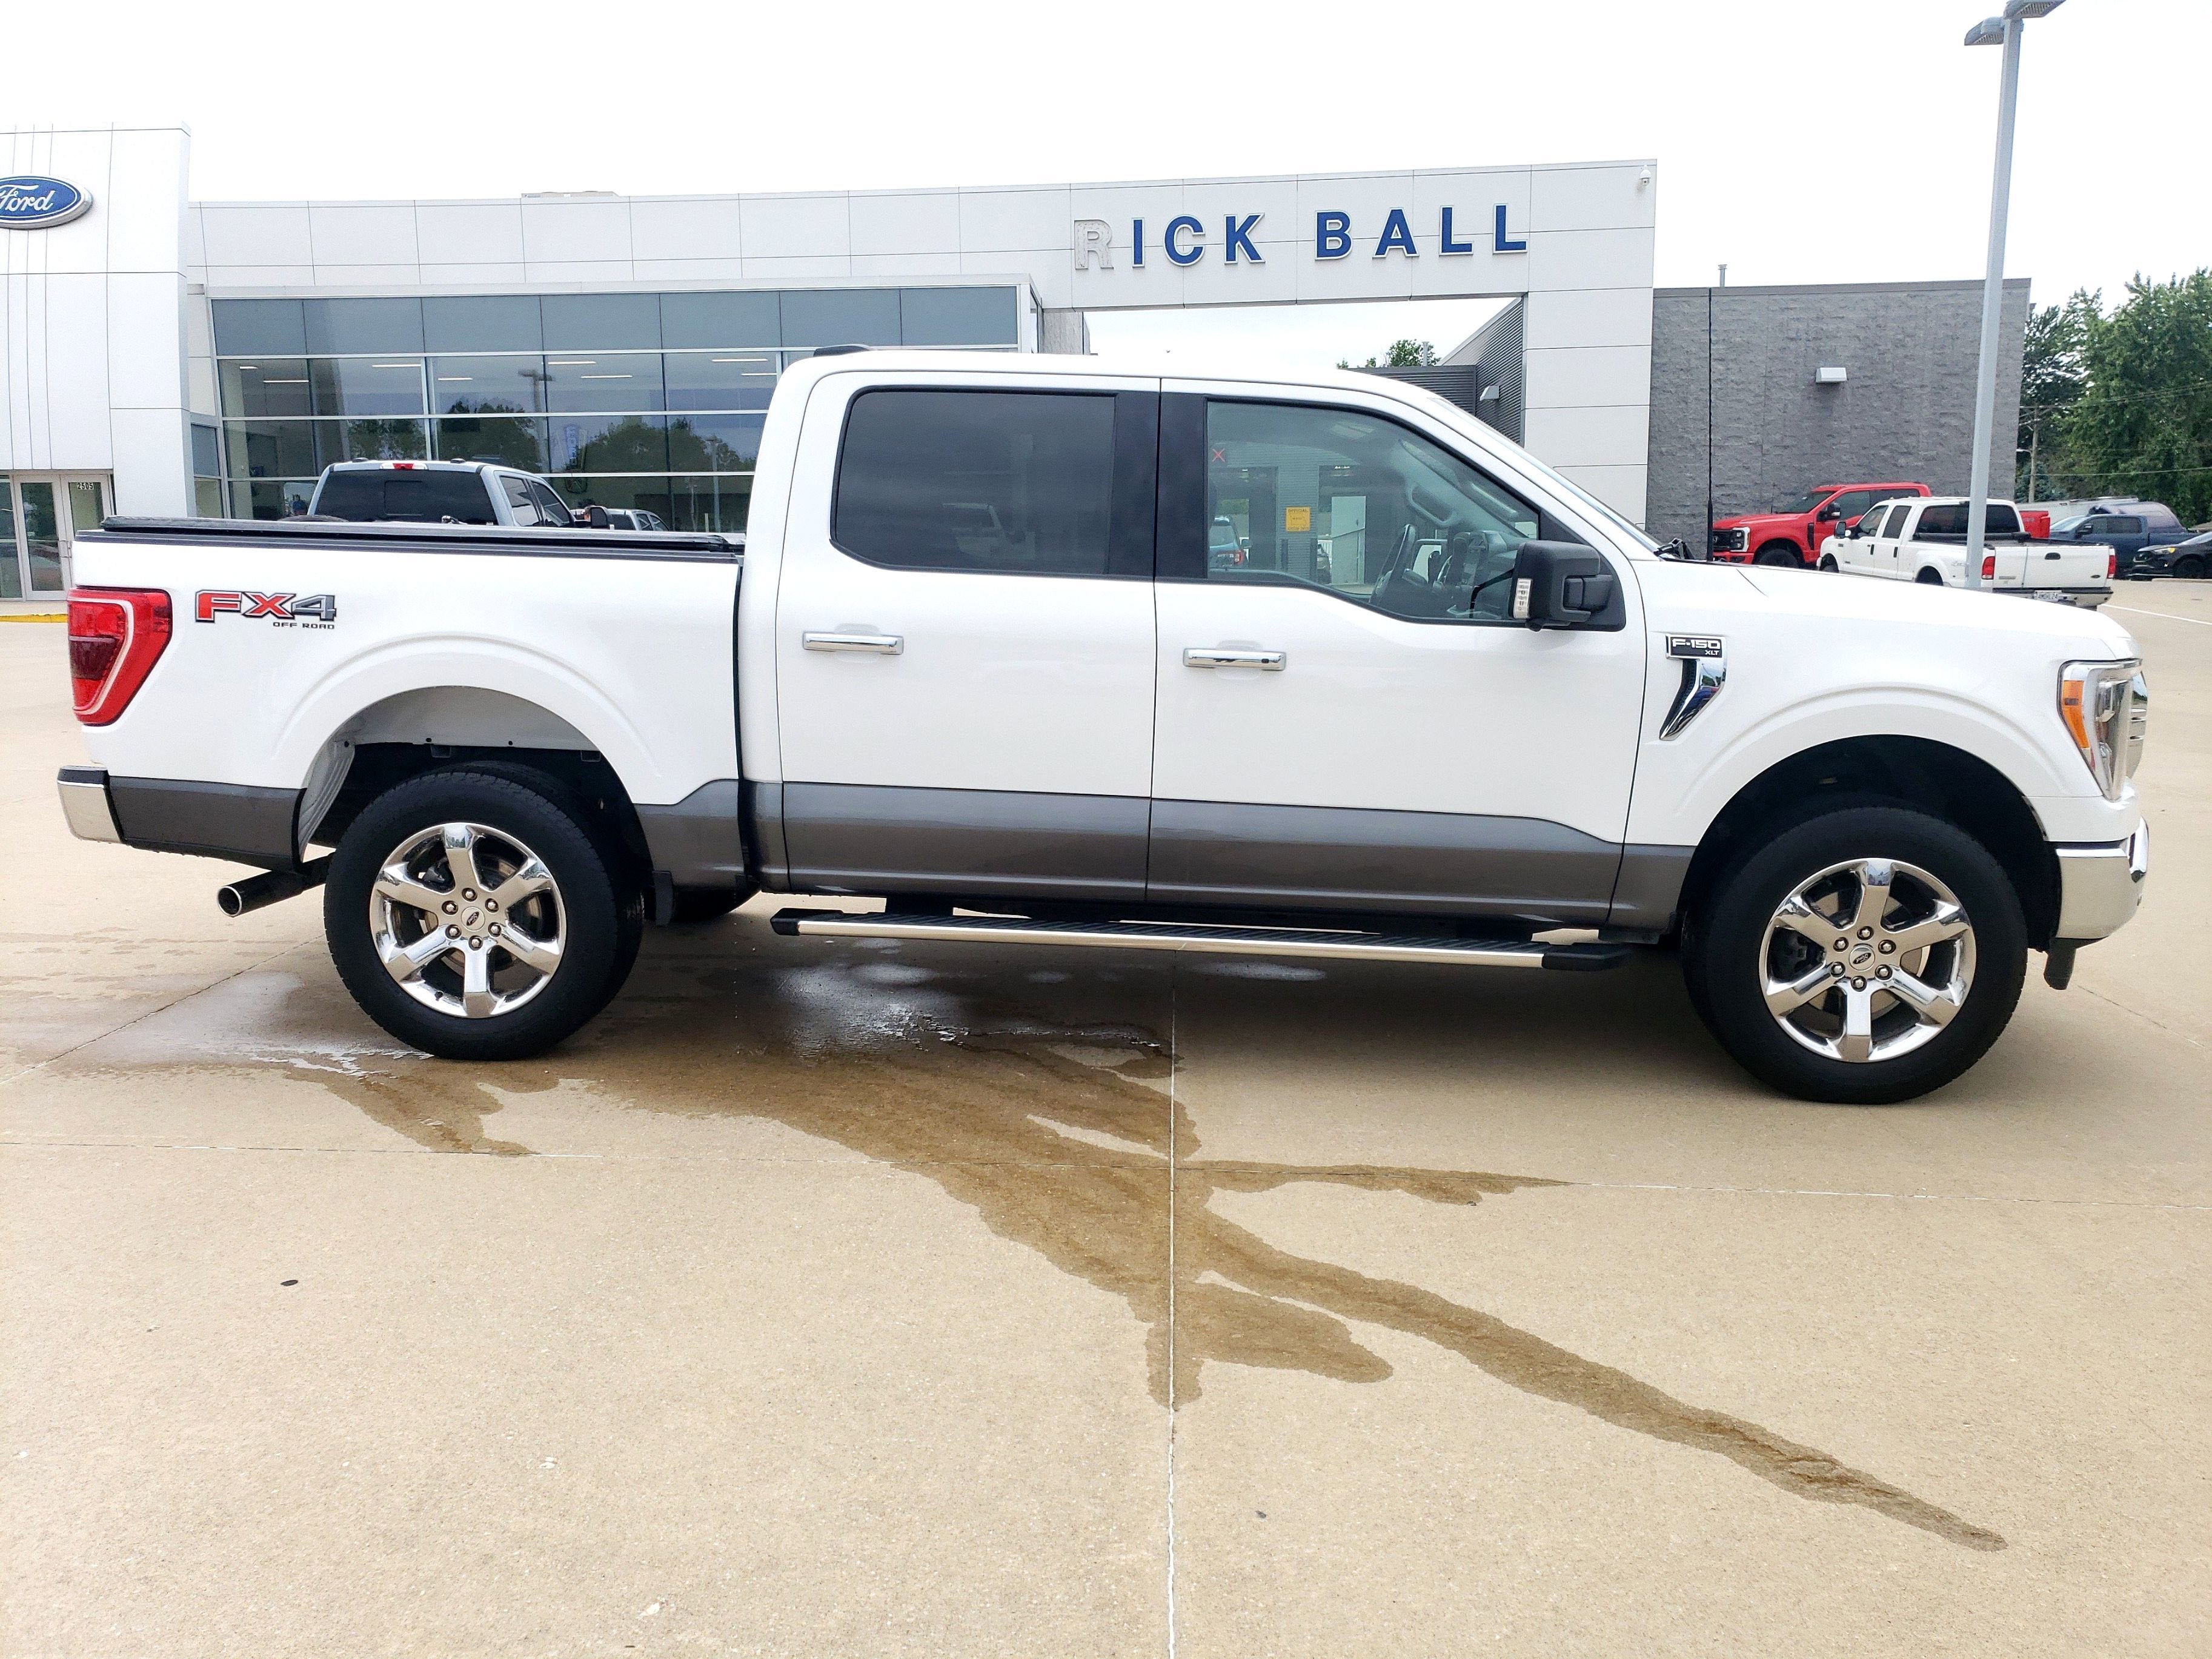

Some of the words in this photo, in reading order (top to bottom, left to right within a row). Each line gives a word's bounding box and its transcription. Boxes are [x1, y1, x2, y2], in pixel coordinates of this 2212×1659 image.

[0, 184, 56, 211] Ford
[1074, 213, 1266, 270] RICK
[1314, 203, 1528, 261] BALL
[196, 590, 337, 623] FX4
[1672, 638, 1721, 650] F-150
